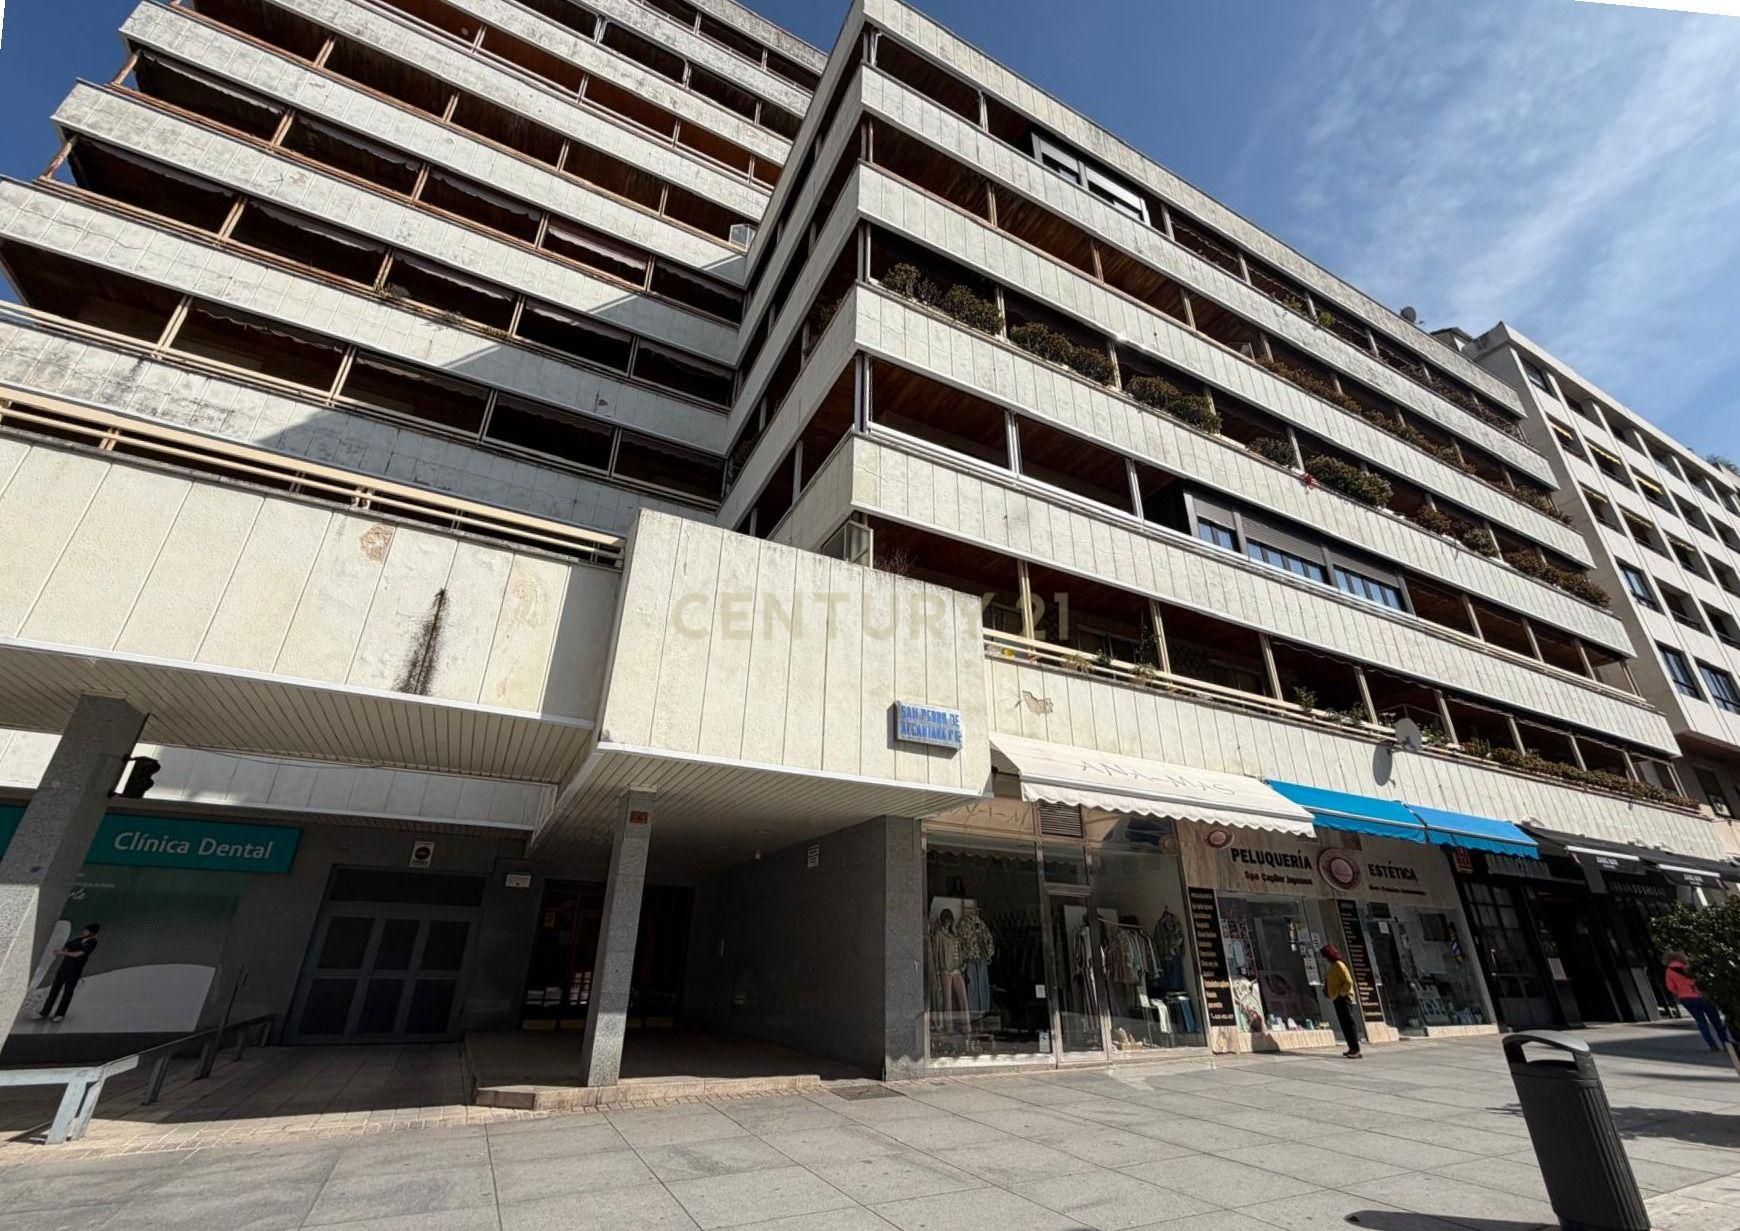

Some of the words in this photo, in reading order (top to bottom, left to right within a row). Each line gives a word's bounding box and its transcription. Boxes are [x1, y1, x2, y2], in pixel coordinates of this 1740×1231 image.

[114, 831, 190, 854] Clínica
[198, 838, 274, 859] Dental
[1231, 847, 1313, 870] PELUQUERÍA
[1368, 860, 1418, 881] ESTÉTICA
